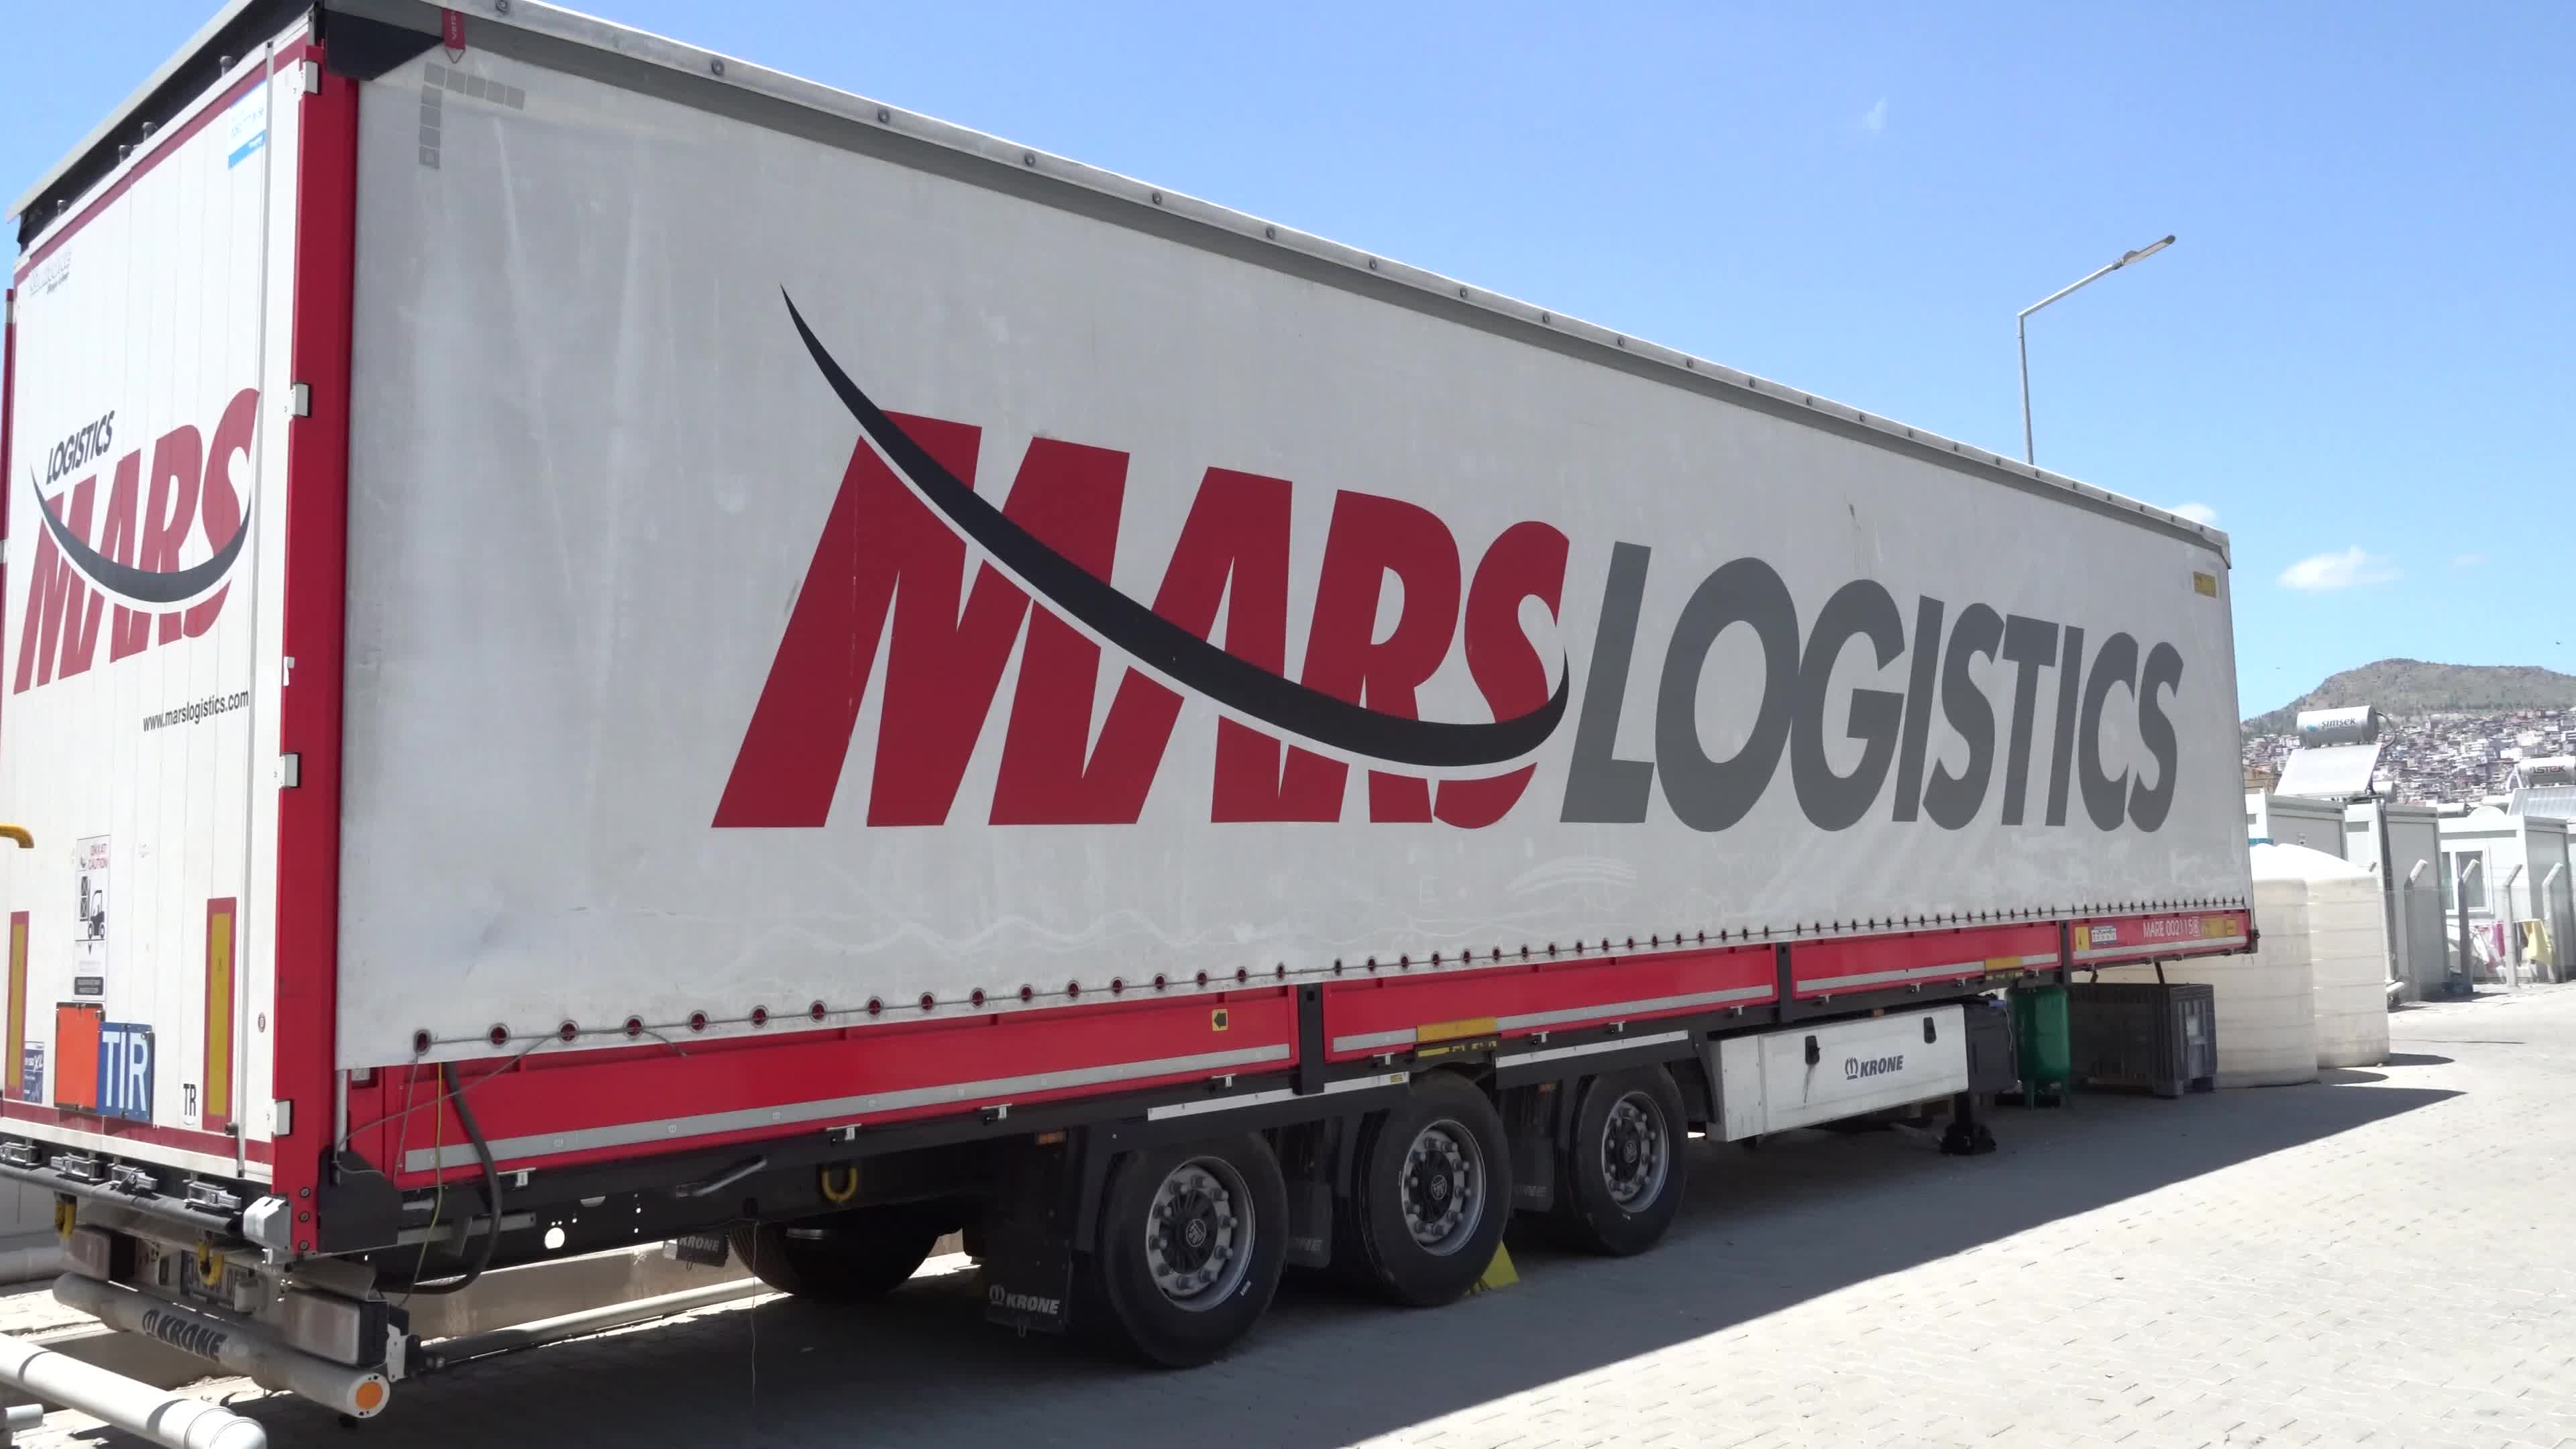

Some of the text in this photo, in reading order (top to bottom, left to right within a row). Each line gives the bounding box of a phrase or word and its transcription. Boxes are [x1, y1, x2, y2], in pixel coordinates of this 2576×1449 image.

[46, 410, 115, 485] LOGISTICS
[14, 388, 260, 694] MARS
[711, 409, 2184, 832] MARS LOGISTICS
[143, 690, 249, 732] www.marslogistics.com
[2143, 920, 2164, 937] MARE
[102, 1030, 148, 1112] TIR
[1860, 1055, 1904, 1077] KRONE
[183, 1083, 197, 1117] TR
[1006, 1293, 1060, 1315] KRONE
[158, 1314, 228, 1363] KRONE
